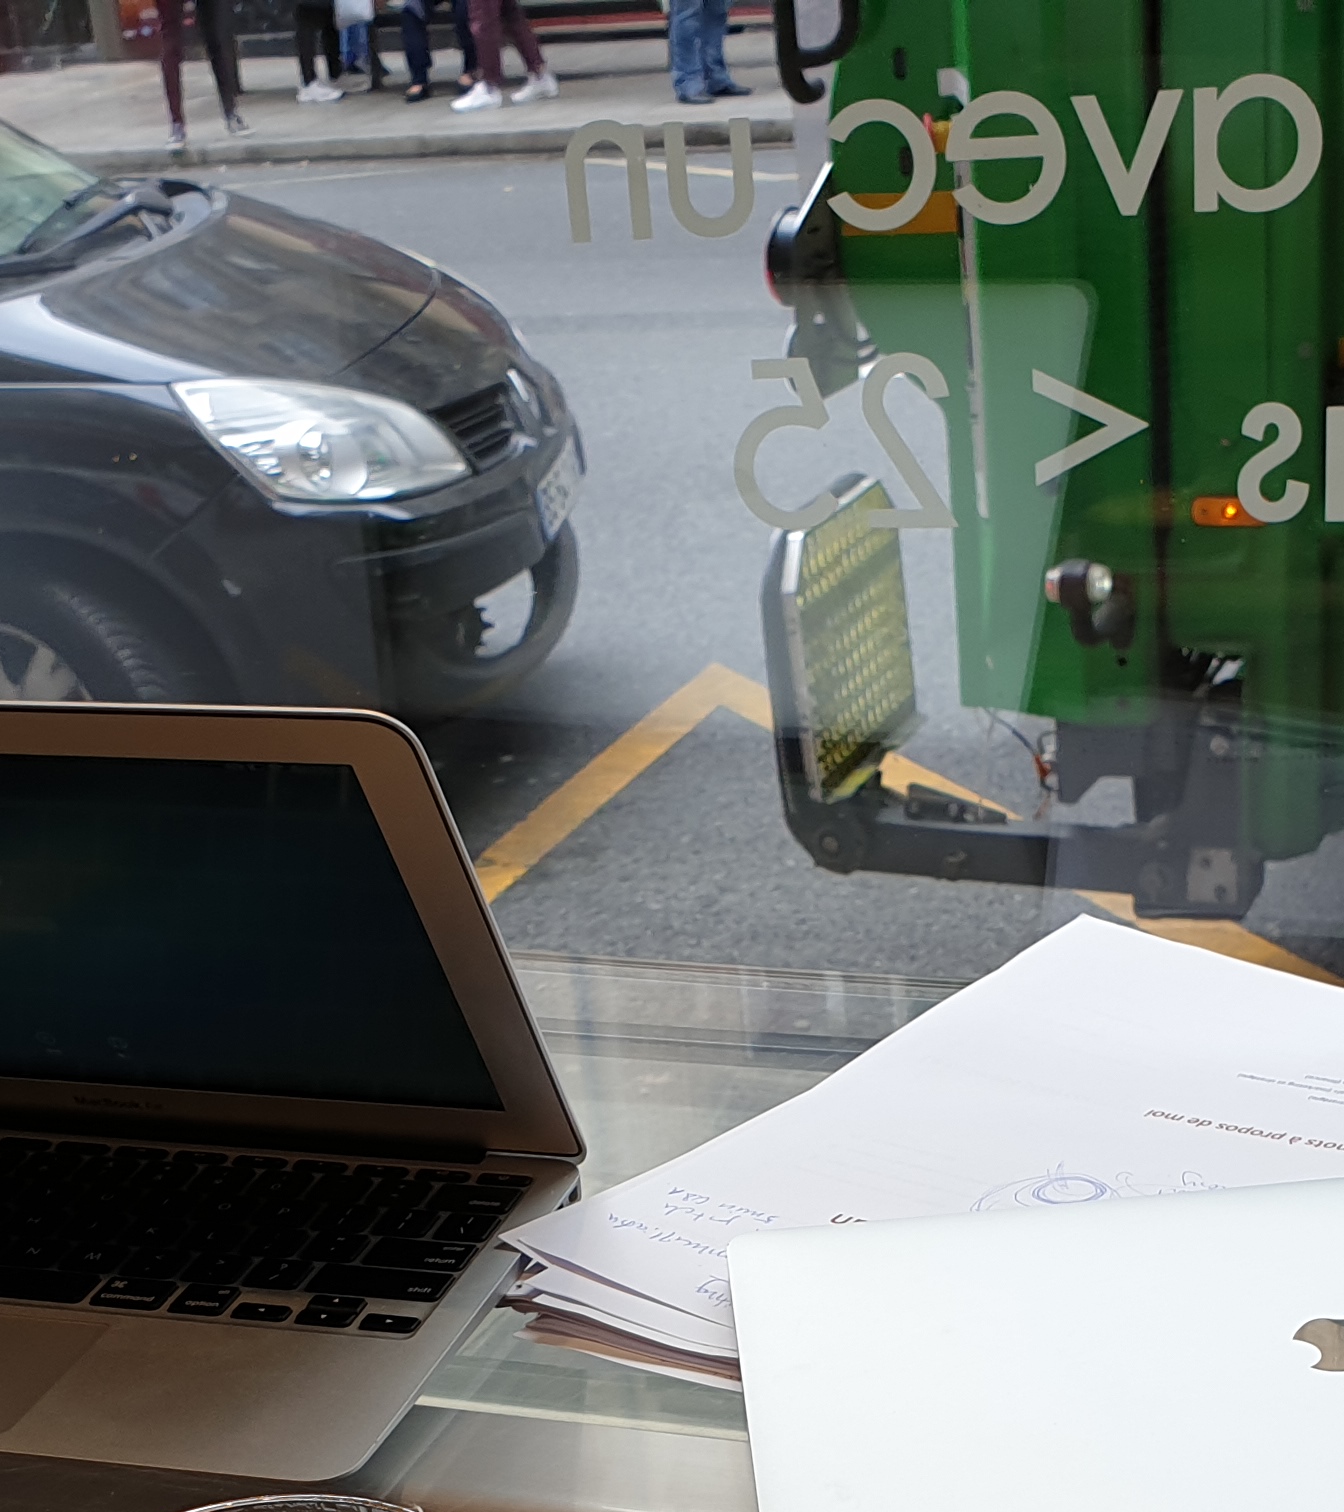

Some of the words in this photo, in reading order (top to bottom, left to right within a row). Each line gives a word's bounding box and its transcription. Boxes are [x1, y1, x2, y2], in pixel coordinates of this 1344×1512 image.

[1144, 1108, 1184, 1123] moi
[1186, 1115, 1212, 1128] de
[1214, 1122, 1287, 1141] propos
[1288, 1134, 1303, 1146] à
